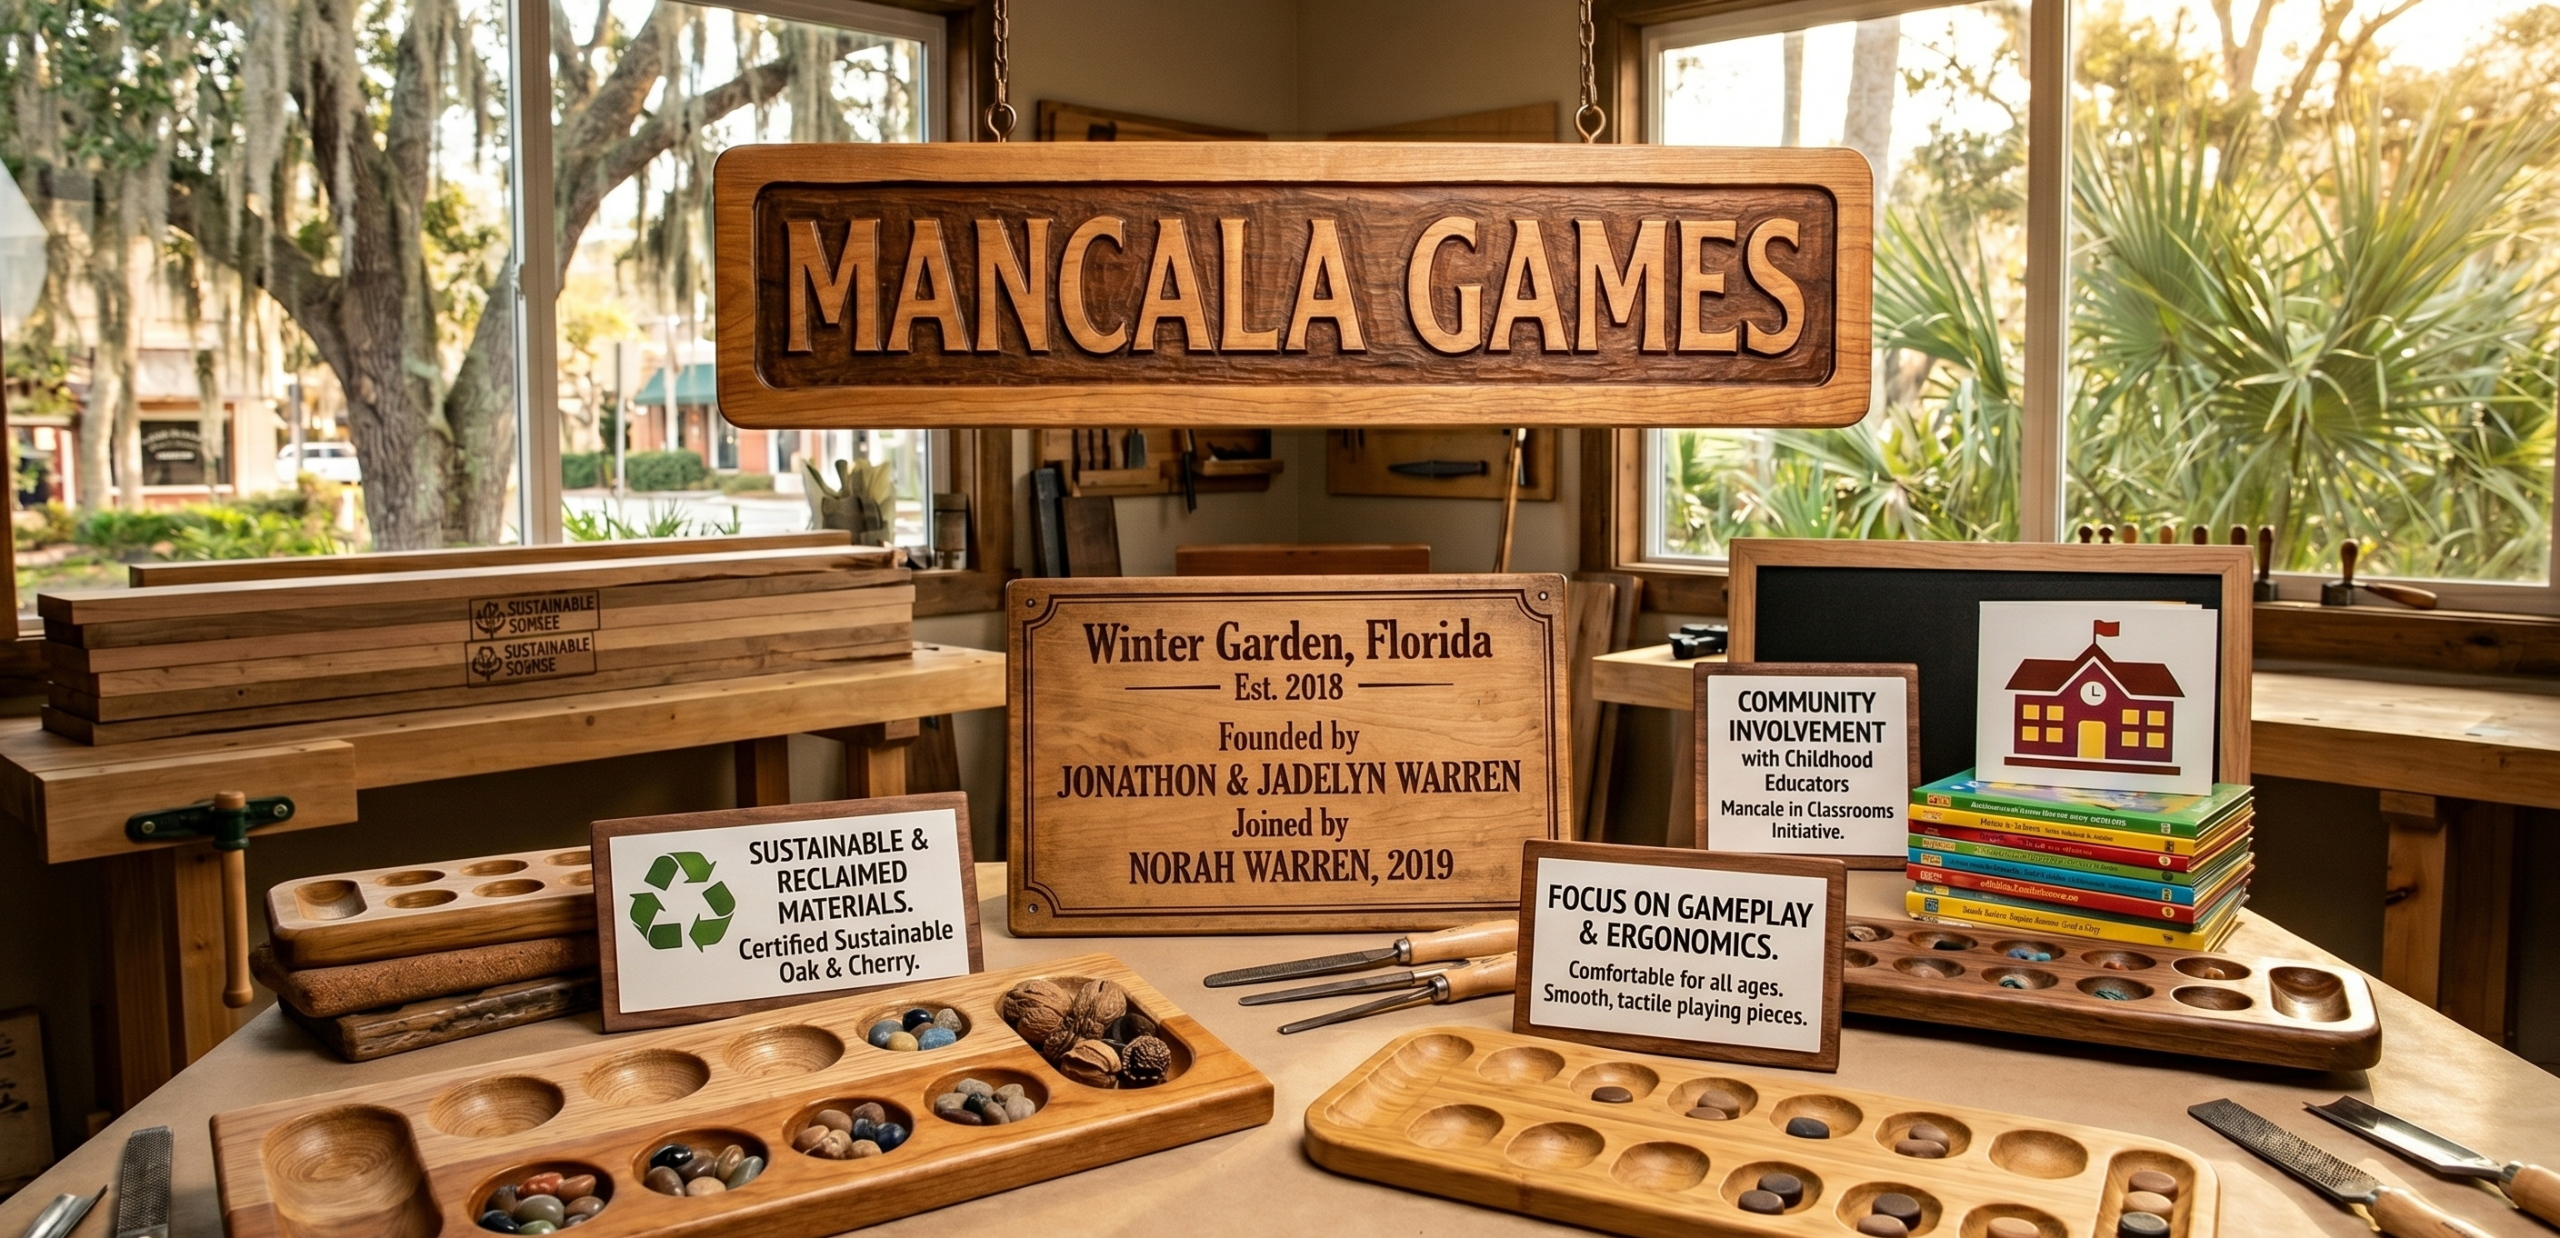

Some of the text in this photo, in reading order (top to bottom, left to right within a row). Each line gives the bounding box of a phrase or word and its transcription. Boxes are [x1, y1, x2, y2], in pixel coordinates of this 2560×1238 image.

[784, 215, 1804, 356] MANCALA GAMES
[508, 595, 594, 617] SUSTAINABLE
[504, 637, 590, 659] SUSTAINABLE
[1083, 618, 1493, 667] Winter Garden, Florida
[1235, 673, 1343, 700] Est. 2018
[1738, 691, 1876, 713] COMMUNITY
[1219, 720, 1360, 755] Founded by
[1730, 720, 1886, 743] INVOLVEMENT
[1742, 749, 1873, 768] with Childhood
[1057, 760, 1521, 798] JONATHON & JADELYN WARREN
[1765, 774, 1849, 792] Educators
[1232, 807, 1349, 842] Joined by
[1721, 800, 1894, 818] Mancale in Classrooms
[749, 828, 929, 865] SUSTAINABLE &
[1772, 823, 1845, 839] Initiative.
[777, 860, 908, 894] RECLAIMED
[1129, 849, 1454, 886] NORAH WARREN, 2019
[778, 890, 913, 924] MATERIALS.
[1548, 884, 1814, 928] FOCUS ON GAMEPLAY
[739, 920, 953, 960] Certified Sustainable
[1579, 920, 1778, 960] & ERGONOMICS.
[779, 952, 921, 983] Oak & Cherry.
[1569, 960, 1783, 999] Comfortable for all ages.
[1544, 983, 1808, 1026] Smooth, tactile playing pieces.
